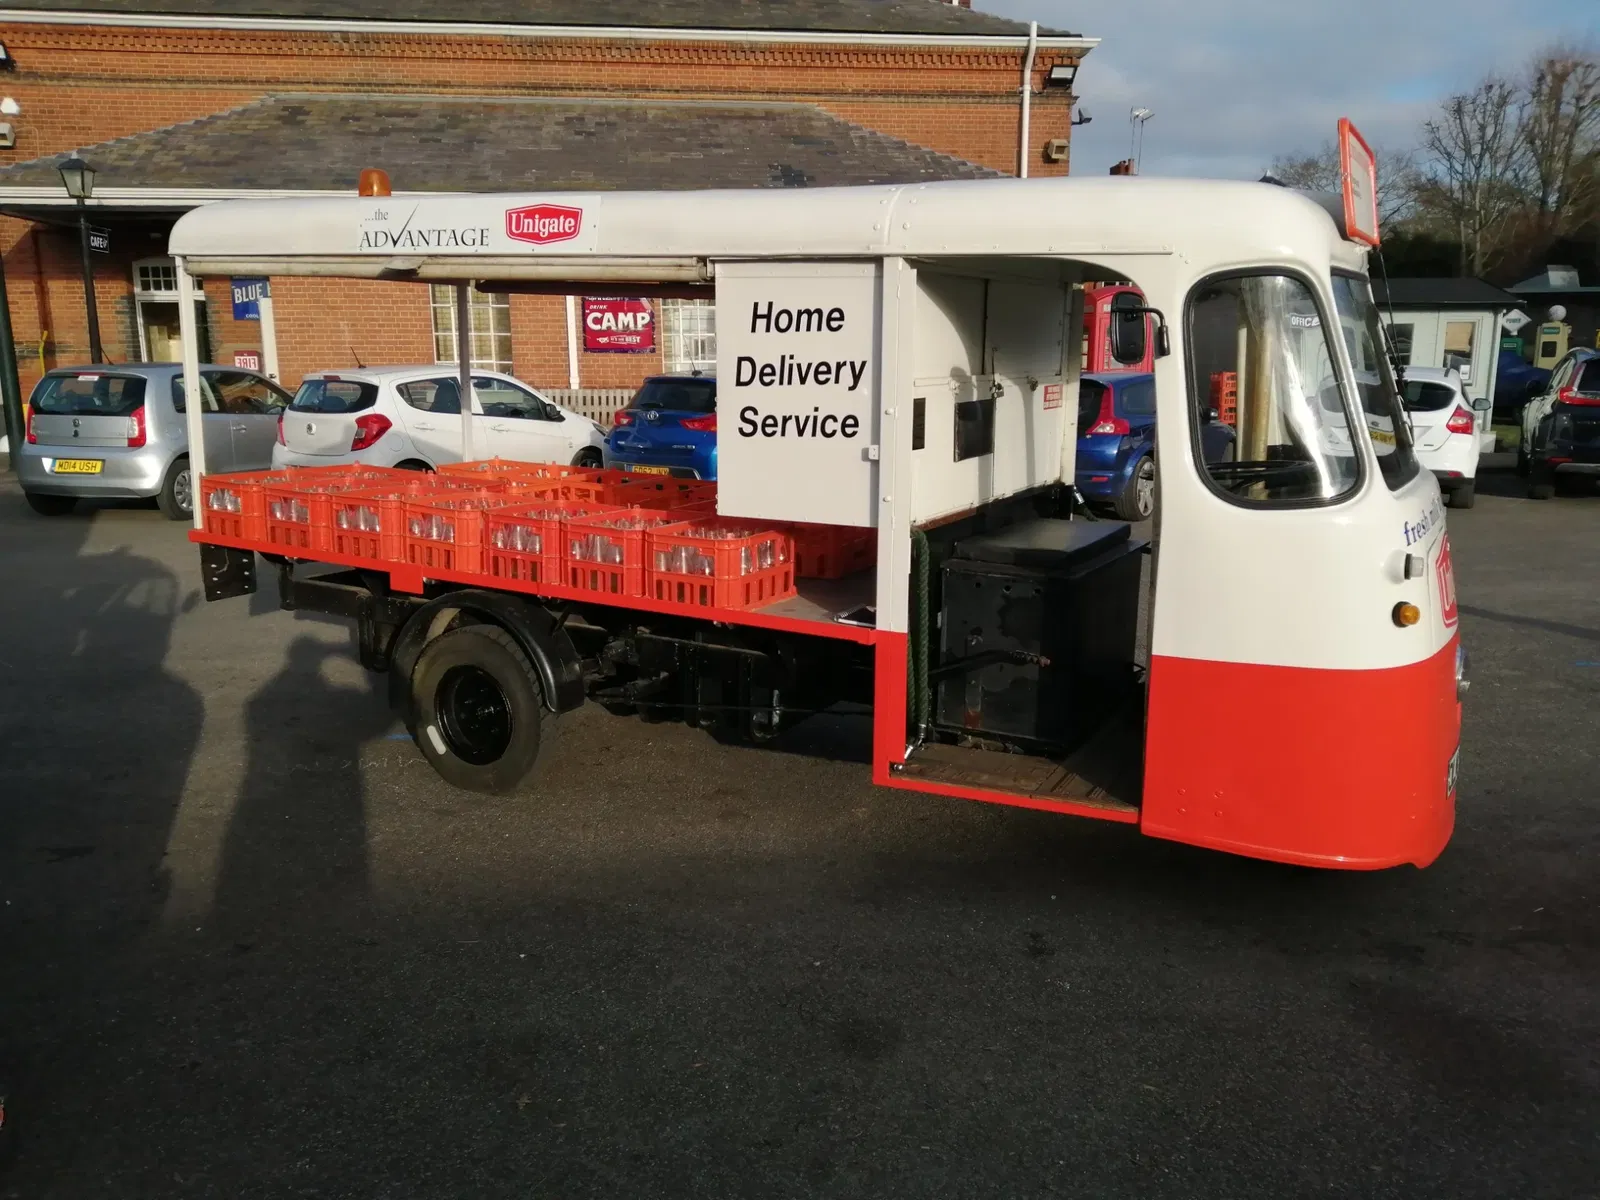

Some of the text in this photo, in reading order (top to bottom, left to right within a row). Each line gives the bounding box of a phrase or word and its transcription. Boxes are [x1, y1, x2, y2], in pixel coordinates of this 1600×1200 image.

[359, 203, 490, 249] ADVANTAGE
[511, 213, 575, 238] Unigate
[233, 283, 264, 304] BLUE
[750, 301, 845, 334] Home
[735, 354, 868, 392] Delivery
[738, 405, 860, 439] Service
[57, 461, 97, 471] MD14 USH
[1403, 509, 1430, 547] fresh
